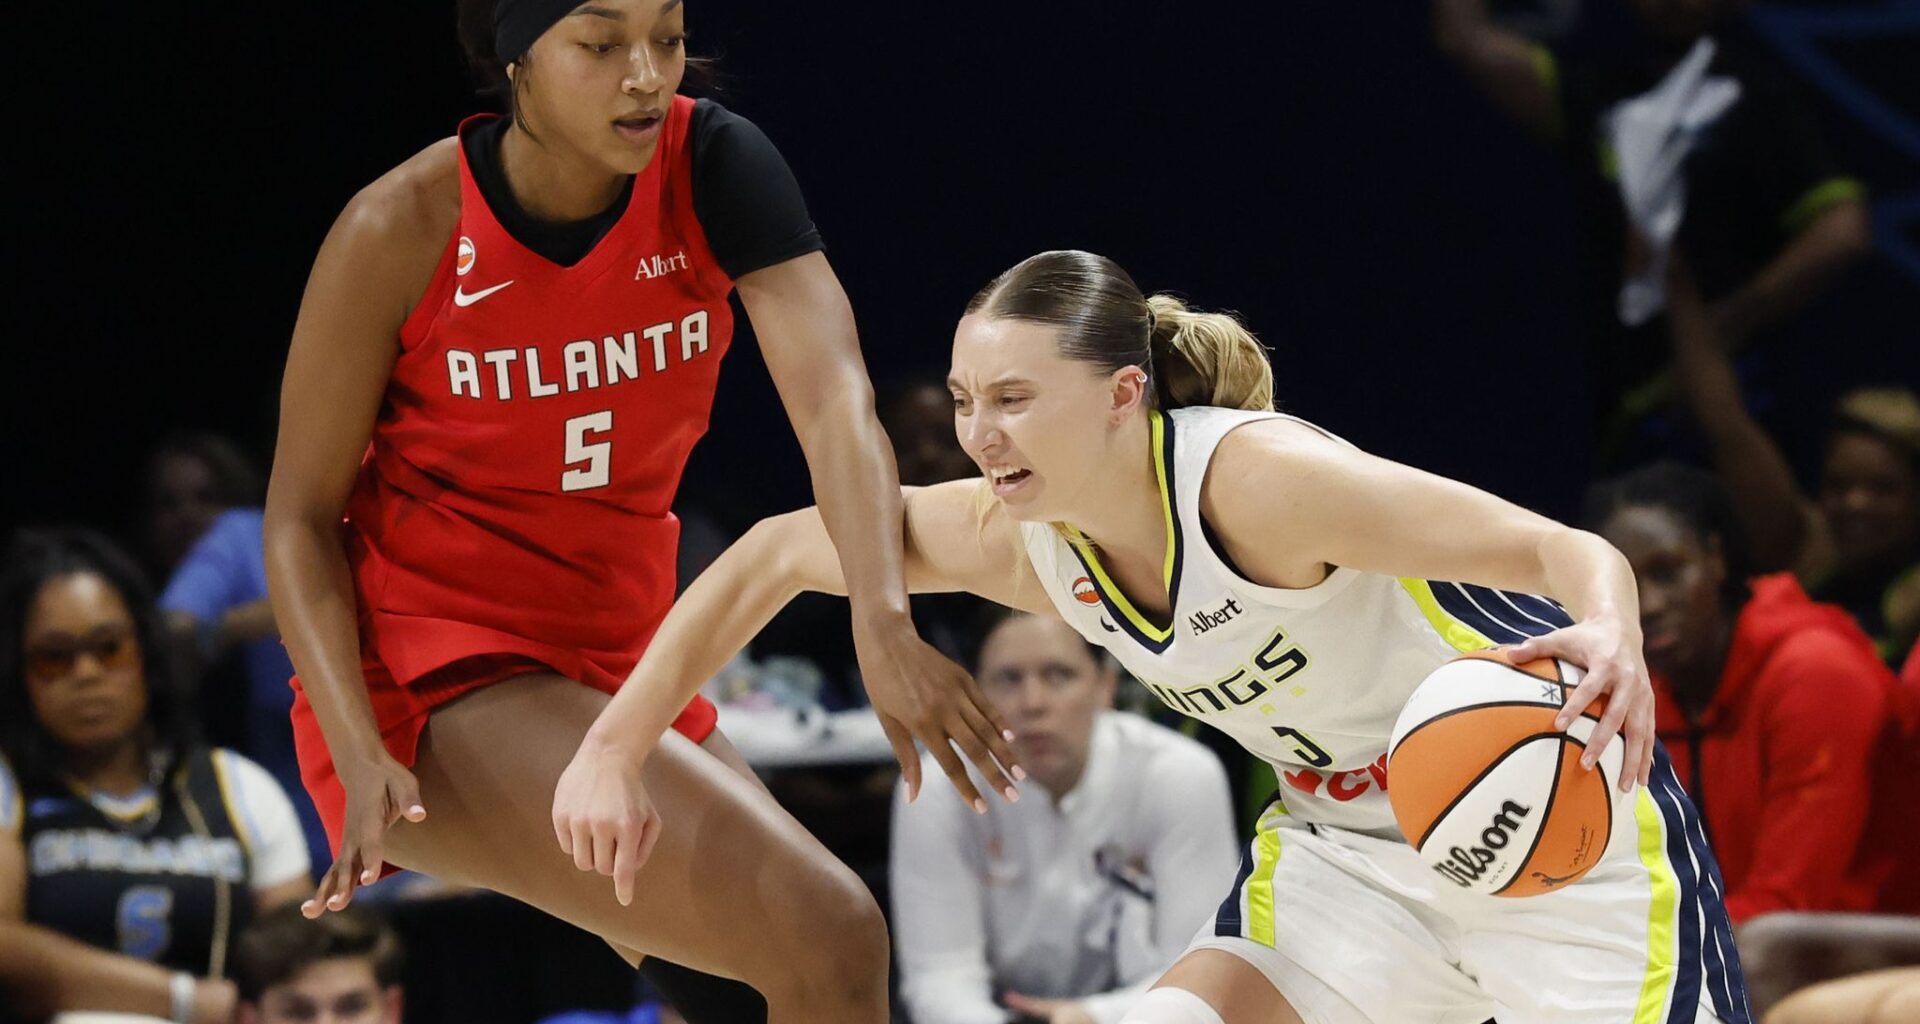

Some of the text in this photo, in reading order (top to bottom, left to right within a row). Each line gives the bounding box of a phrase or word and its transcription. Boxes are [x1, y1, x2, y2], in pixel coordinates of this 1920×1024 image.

[446, 310, 709, 401] ATLANTA
[561, 409, 613, 493] 5
[1188, 597, 1244, 637] Albert
[1138, 629, 1309, 716] INGS
